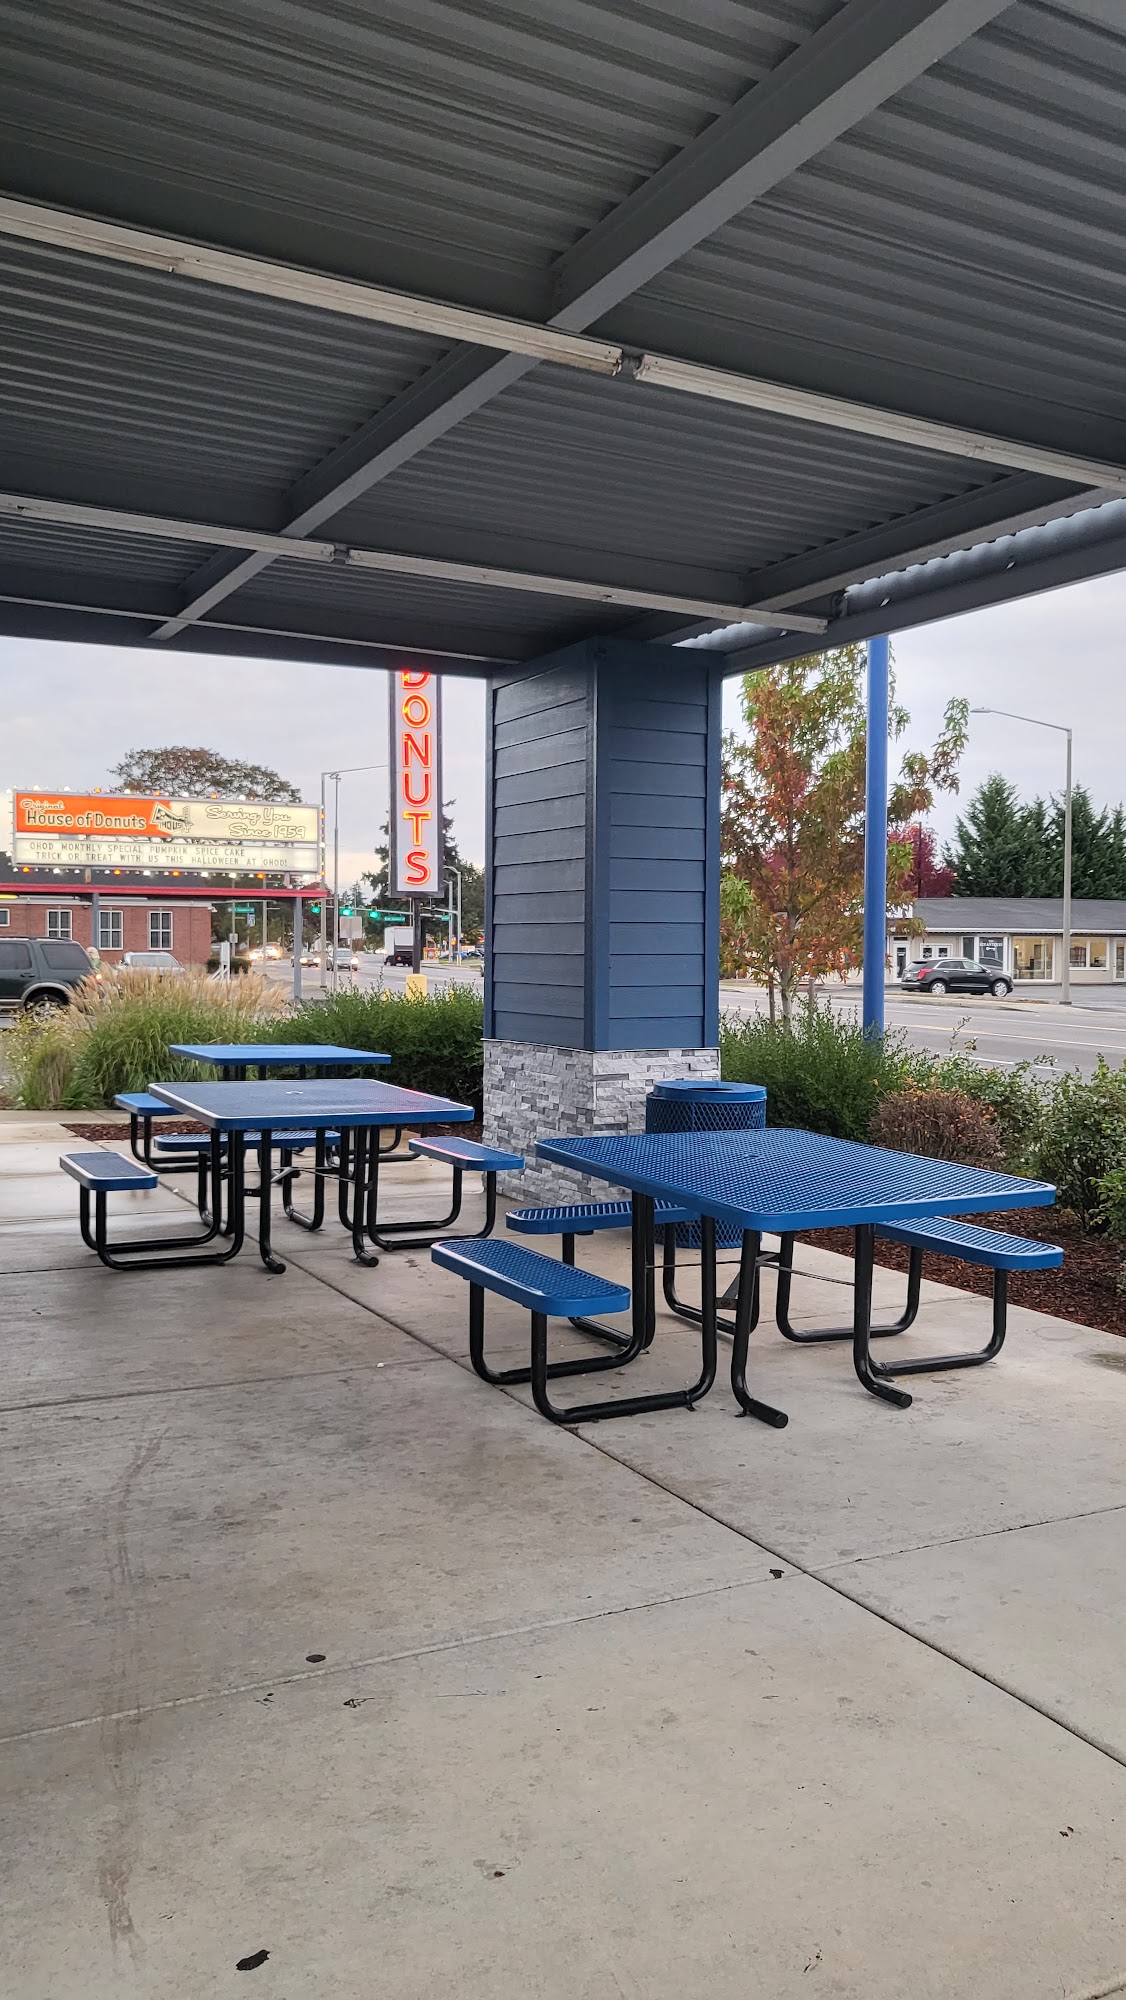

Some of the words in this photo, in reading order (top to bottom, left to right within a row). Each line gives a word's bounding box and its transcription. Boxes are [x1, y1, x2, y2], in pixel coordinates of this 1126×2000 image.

[22, 800, 64, 812] Original
[27, 810, 73, 826] House
[77, 812, 93, 827] of
[95, 813, 147, 829] Donuts
[206, 805, 261, 825] Serving
[263, 808, 291, 826] You
[229, 822, 271, 837] Since
[274, 825, 306, 839] 1959
[30, 842, 54, 851] OHOD
[61, 843, 101, 852] MONTHLY
[107, 844, 143, 853] SPECIAL
[150, 845, 188, 855] PUMPKIN
[195, 847, 219, 856] SPICE
[224, 848, 245, 857] CAKE
[36, 851, 62, 860] TRICK
[68, 852, 80, 861] OR
[86, 853, 113, 862] TREAT
[120, 854, 141, 863] WITH
[148, 855, 159, 863] US
[165, 855, 184, 864] THIS
[191, 856, 239, 866] HALLOWEEN
[246, 858, 257, 866] AT
